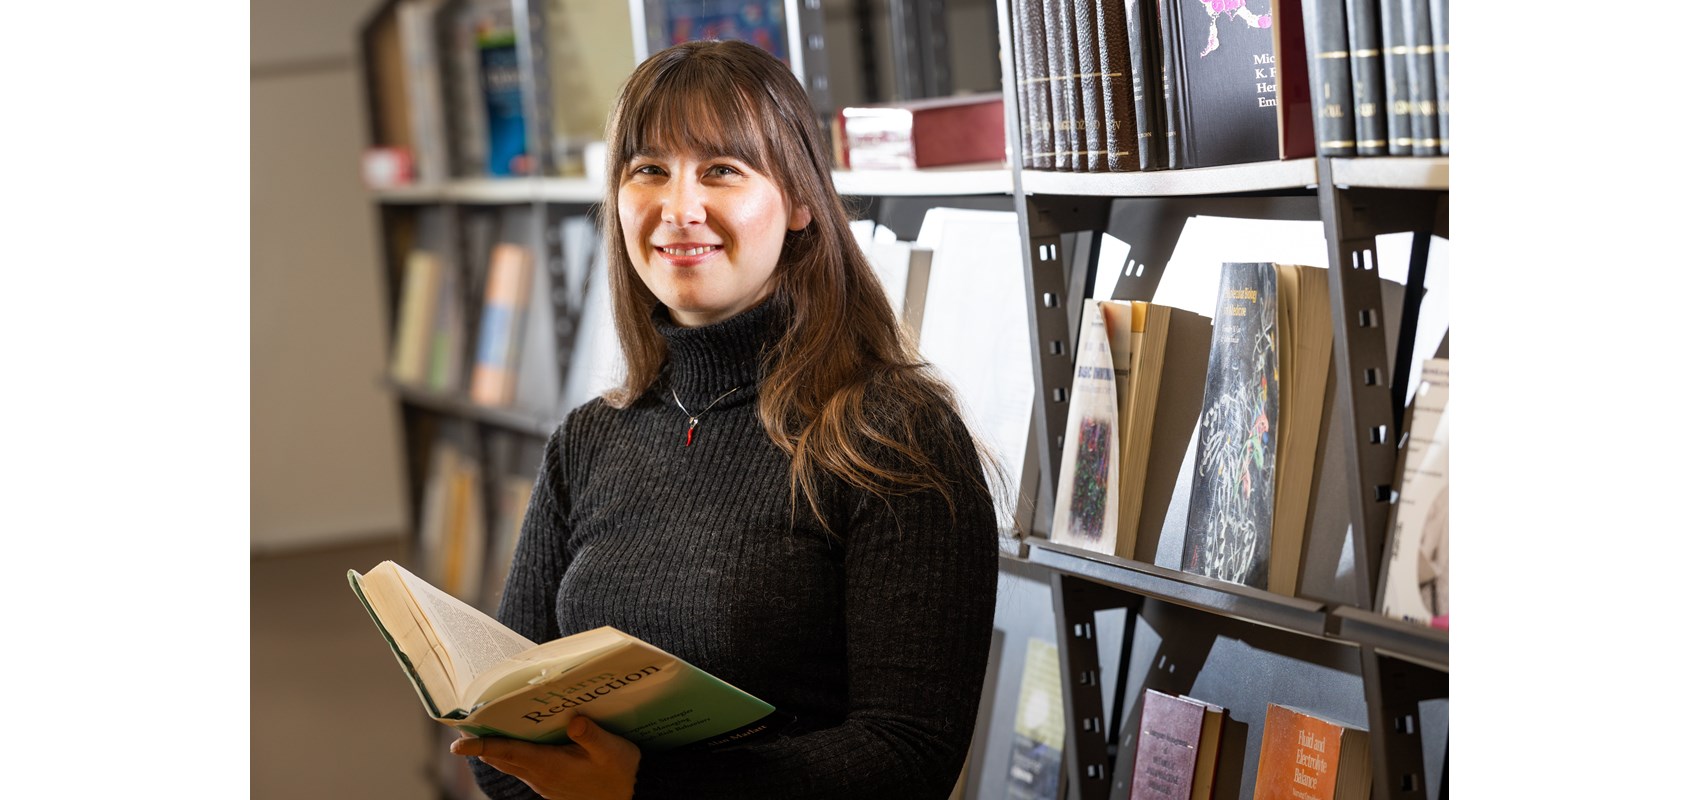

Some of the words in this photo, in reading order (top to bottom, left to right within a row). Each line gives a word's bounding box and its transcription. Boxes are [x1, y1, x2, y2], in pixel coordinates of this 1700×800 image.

[1254, 68, 1268, 79] K.
[521, 664, 662, 724] Reduction
[531, 671, 617, 705] Harm
[728, 724, 768, 740] Marlatt
[1298, 729, 1314, 749] Fluid
[1313, 736, 1326, 753] and
[1296, 748, 1328, 774] Electrolyte
[1294, 767, 1318, 790] Balance
